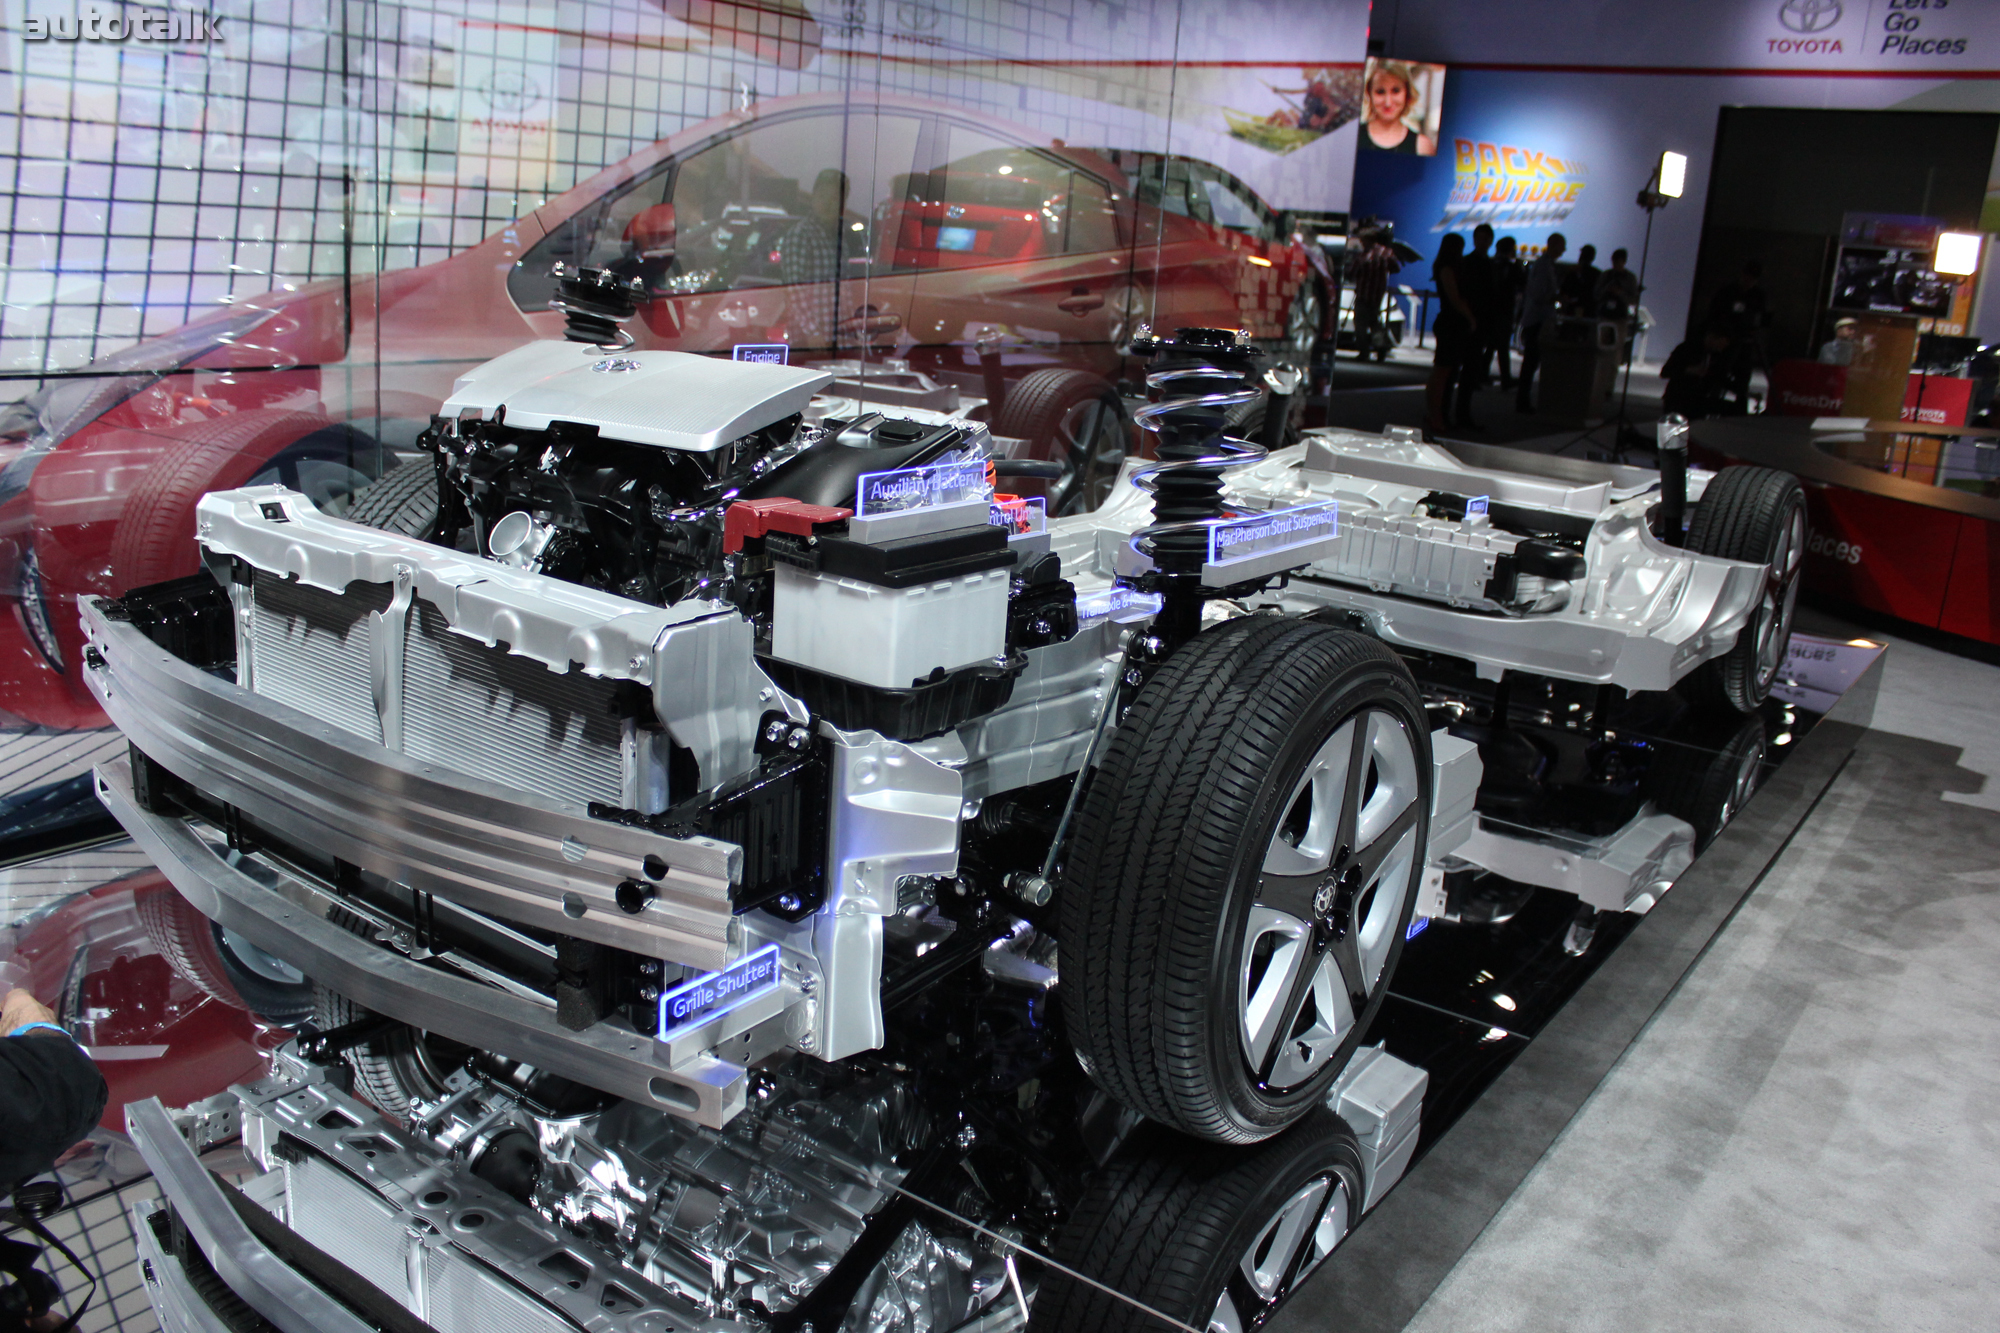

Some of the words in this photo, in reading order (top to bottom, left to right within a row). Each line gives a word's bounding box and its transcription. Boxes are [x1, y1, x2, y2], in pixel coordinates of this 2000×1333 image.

[1884, 12, 1920, 32] Go
[1766, 39, 1843, 54] TOYOTA
[1879, 34, 1967, 55] Places
[1454, 139, 1557, 179] BACK
[1455, 175, 1475, 190] TO
[1472, 177, 1586, 203] FUTURE
[1783, 390, 1843, 410] TeenDri
[871, 478, 931, 500] Auxiliary
[932, 471, 979, 491] Battery
[989, 507, 1013, 525] ntrol
[1015, 505, 1036, 523] Unit
[1217, 525, 1270, 548] MacPherson
[1271, 519, 1292, 536] Strut
[1293, 509, 1336, 531] Suspension
[1806, 527, 1863, 564] laces
[1081, 597, 1121, 619] Transaxle
[673, 987, 714, 1018] Grille
[716, 960, 773, 998] Shutter
